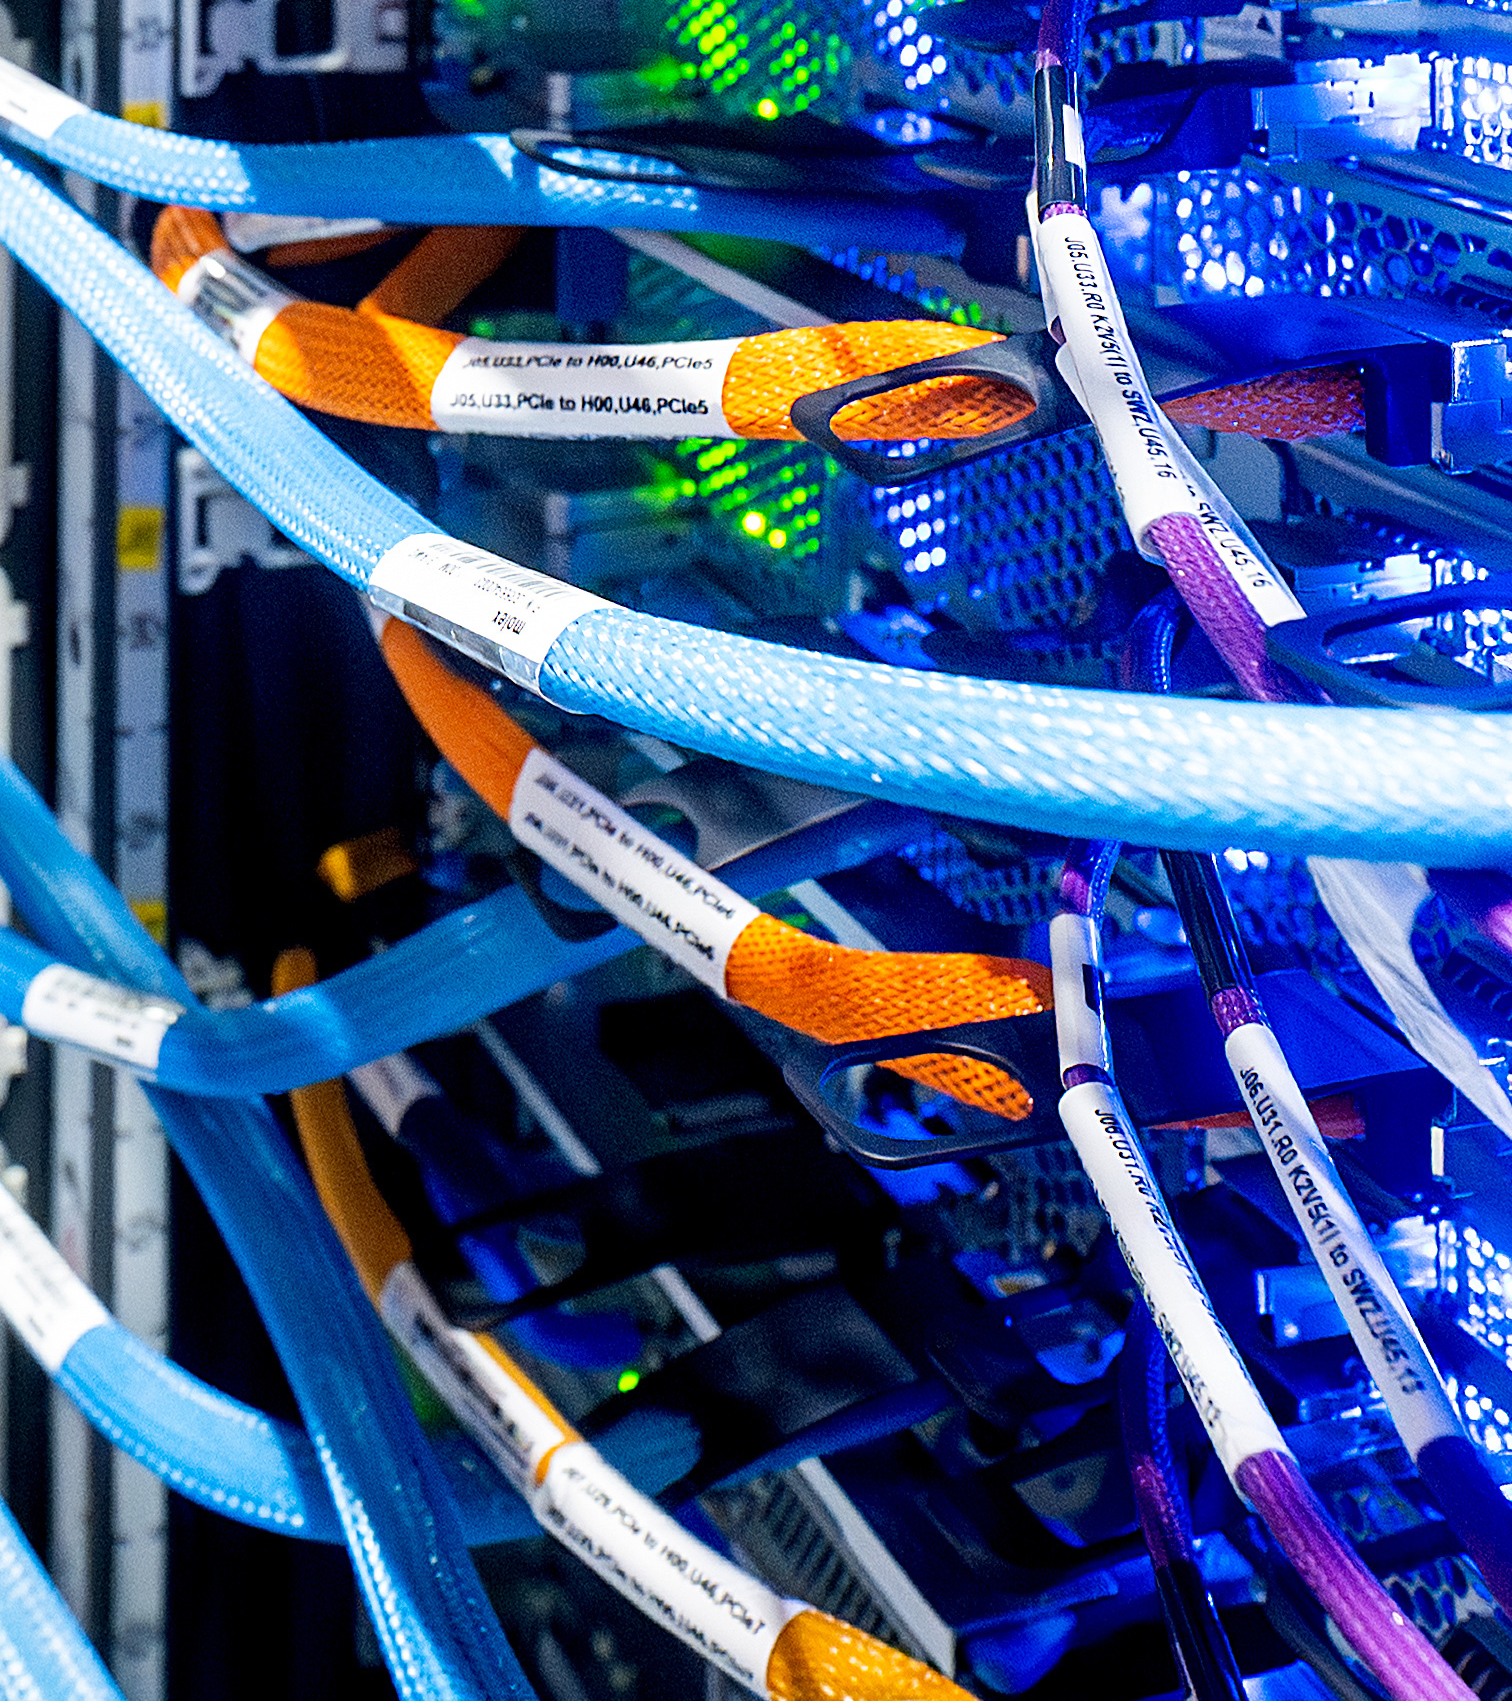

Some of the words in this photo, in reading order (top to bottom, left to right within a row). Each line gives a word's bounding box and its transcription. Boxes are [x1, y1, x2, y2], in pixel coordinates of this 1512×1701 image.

[1062, 231, 1106, 315] J05.U33.R0
[1111, 366, 1134, 390] to
[567, 357, 582, 369] to
[588, 355, 712, 370] H00,U46,PCIe5
[560, 396, 575, 411] to
[582, 395, 708, 416] H00,U46,PCIe5
[488, 608, 526, 638] molex
[1235, 1063, 1302, 1167] J06.U31.R0
[1327, 1242, 1354, 1268] to
